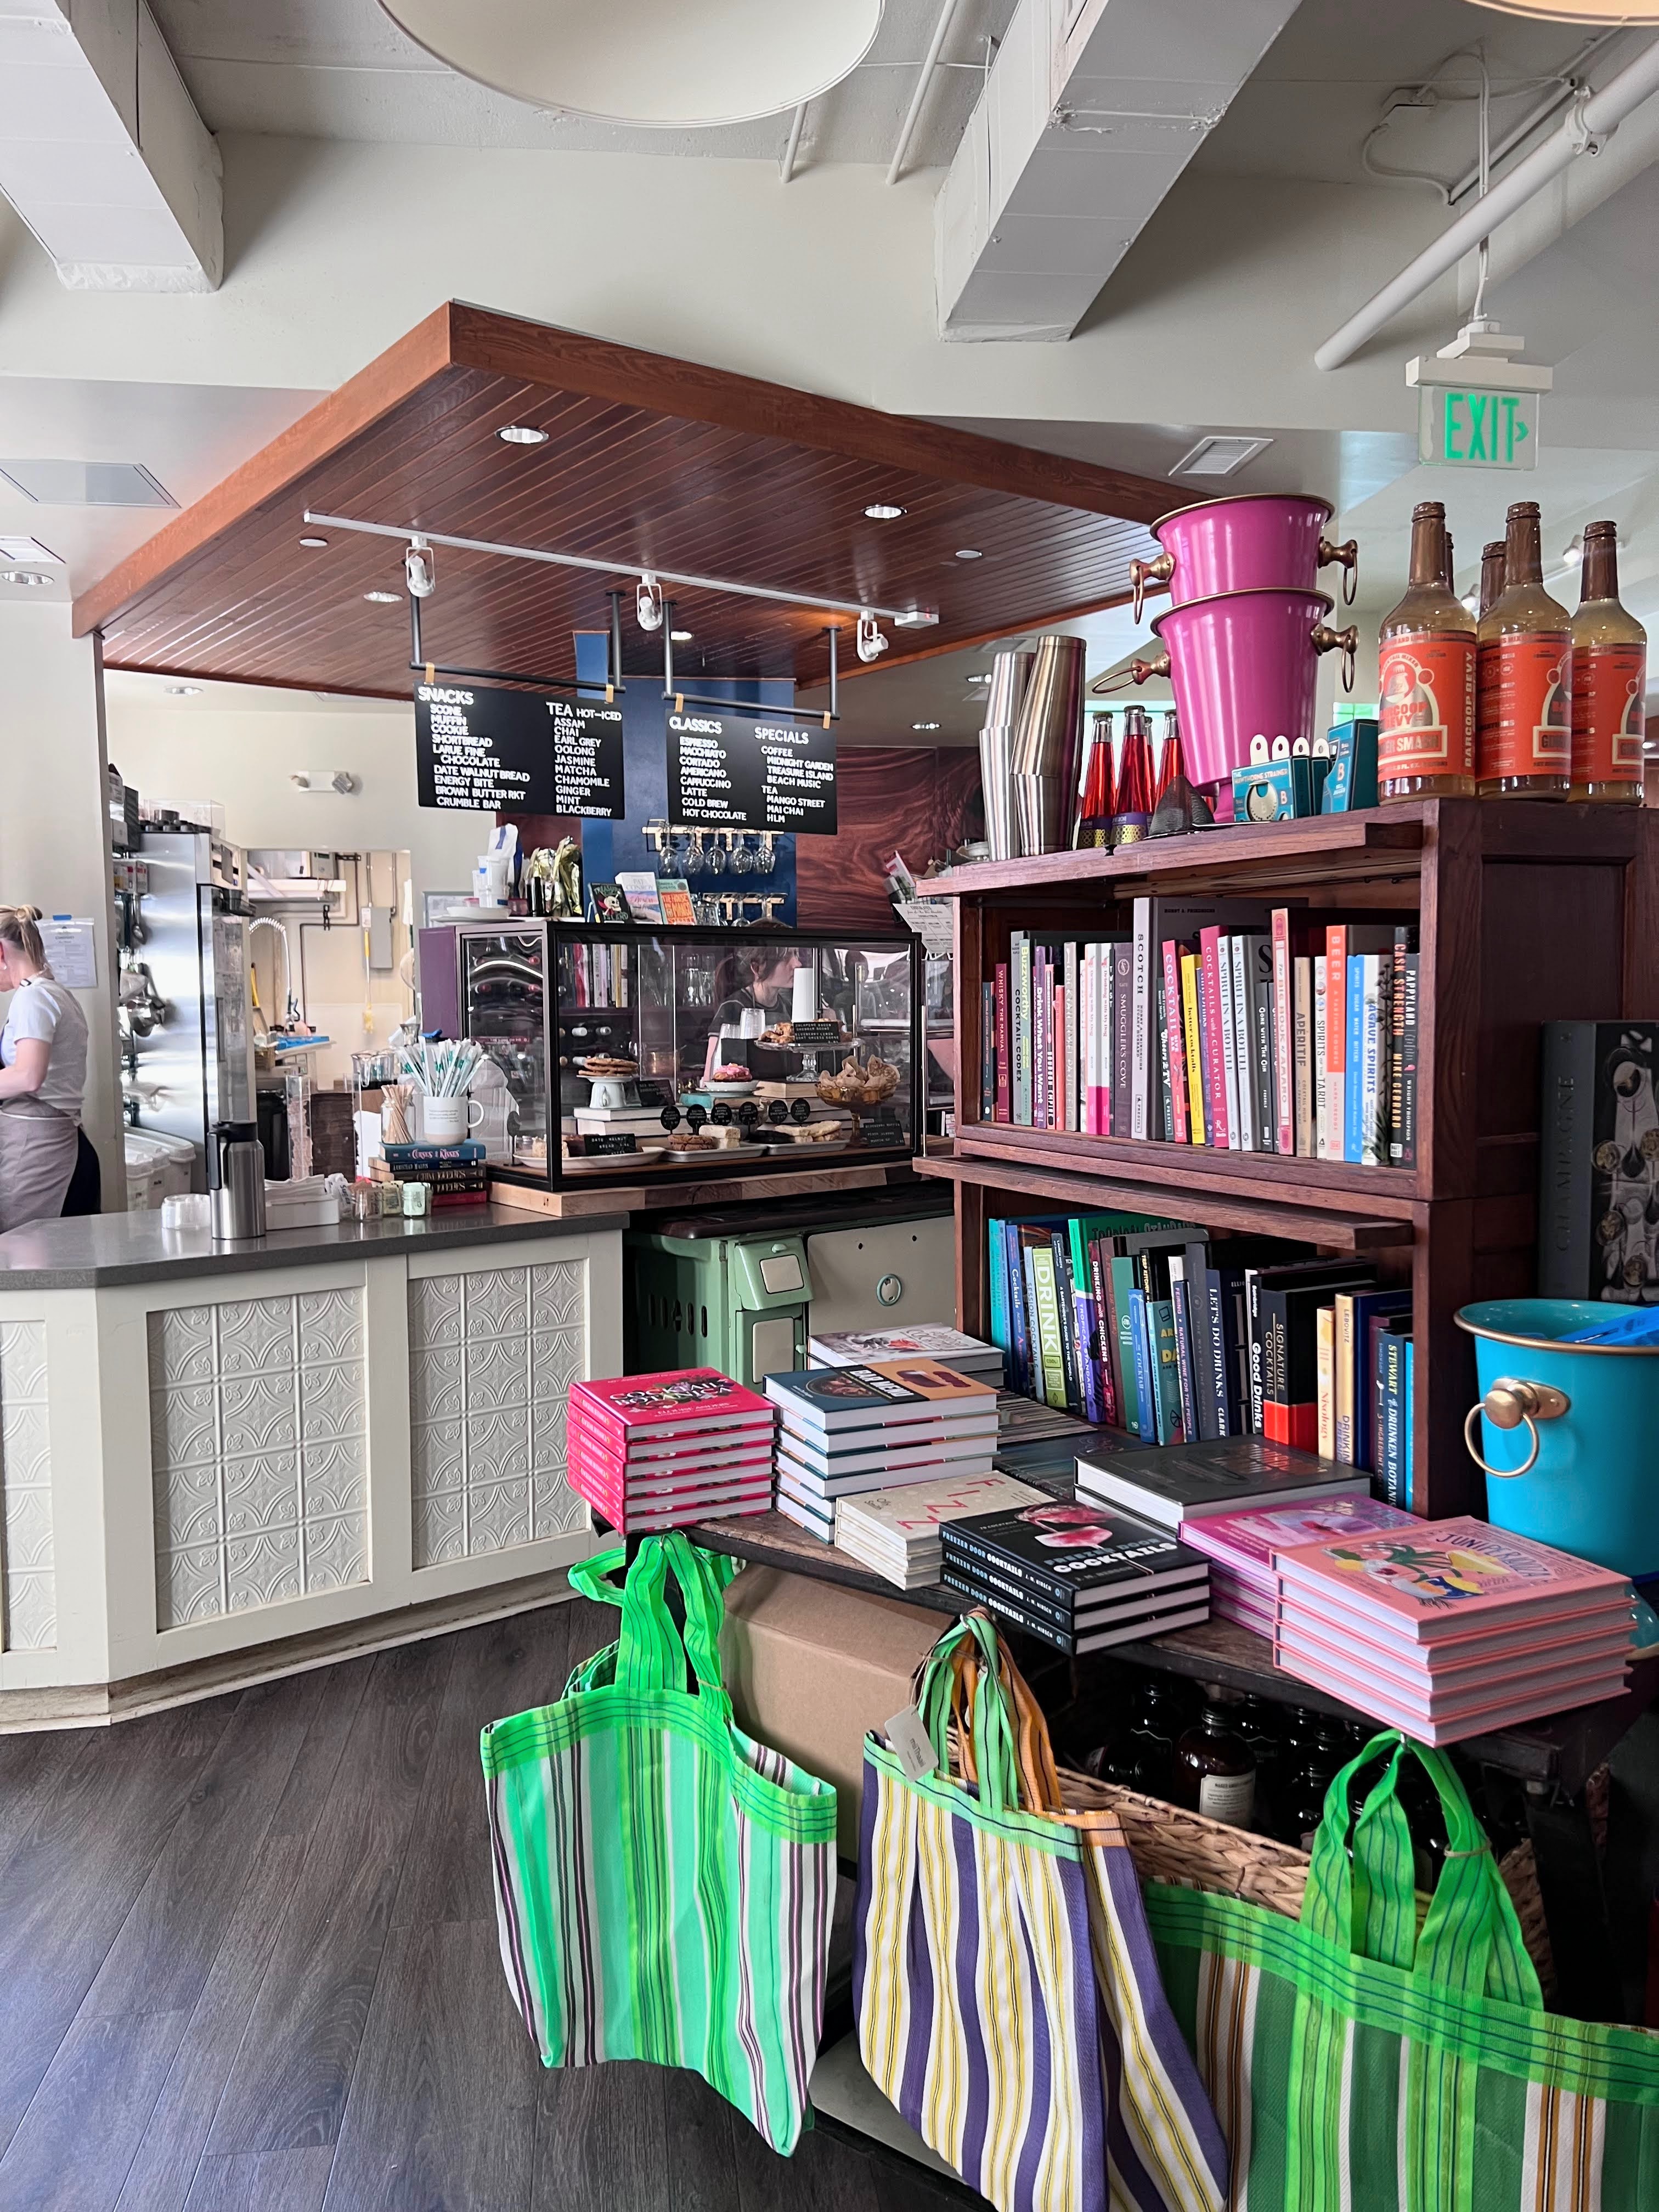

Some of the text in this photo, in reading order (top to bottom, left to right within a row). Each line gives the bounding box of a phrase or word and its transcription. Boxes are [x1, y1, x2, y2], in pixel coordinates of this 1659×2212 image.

[1445, 392, 1520, 462] EXIT
[418, 686, 473, 705] SNACKS
[430, 704, 462, 716] SCONE
[546, 702, 572, 716] TEA
[1465, 651, 1475, 767] BARCOOP BEVY
[431, 714, 466, 726] MUFFIN
[554, 718, 585, 729] ASSAM
[669, 716, 723, 735] CLASSICS
[431, 724, 469, 736] COOKIE
[554, 727, 579, 736] CHAI
[755, 727, 809, 744] SPECIALS
[432, 734, 493, 747] SHORTBREAD
[555, 735, 601, 748] EARL GREY
[680, 736, 718, 748] ESPRESSO
[433, 744, 486, 757] LARUE FINE
[555, 744, 595, 756] OOLONG
[680, 746, 726, 759] MACCHIATO
[761, 746, 793, 757] COFFEE
[441, 754, 500, 768] CHOCOLATE
[555, 755, 595, 766] JASMINE
[679, 757, 720, 768] CORTADO
[767, 757, 833, 771] MIDNIGHT GARDEN
[435, 765, 530, 782] DATE WALNUT BREAD
[555, 765, 596, 776] MATCHA
[680, 767, 726, 778] AMERICANO
[767, 766, 833, 781] TREASURE ISLAND
[435, 776, 494, 788] ENERGY BITE
[555, 775, 610, 787] CHAMOMILE
[680, 777, 731, 789] CAPPUCCINO
[767, 775, 821, 789] BEACH MUSIC
[436, 785, 507, 799] BROWN BUTTER
[556, 785, 591, 796] GINGER
[681, 788, 708, 797] LATTE
[761, 785, 778, 795] TEA
[437, 797, 501, 809] CRUMBLE BAR
[556, 795, 580, 805] MINT
[682, 798, 728, 809] COLD BREW
[767, 795, 825, 808] MANGO STREET
[556, 804, 612, 817] BLACKBERRY
[682, 808, 747, 821] HOT CHOCOLATE
[767, 805, 804, 816] MAI CHAI
[767, 815, 785, 823] HLM
[1331, 936, 1340, 980] BEER
[1220, 962, 1228, 998] SPIRIT
[1234, 961, 1243, 999] SPIRIT
[1165, 954, 1177, 1032] COCKTAIL
[1393, 944, 1406, 1036] CASK STRENGTH
[1406, 970, 1415, 1025] PAPPYLAND
[1205, 947, 1216, 1014] COCKTAILS
[1211, 1040, 1221, 1099] CURATOR
[1367, 1005, 1377, 1093] AGAVE SPIRITS
[1317, 1020, 1326, 1109] SPIRITS TAROT
[1393, 1054, 1402, 1078] MIKE
[1162, 1070, 1170, 1088] TV
[412, 1149, 459, 1159] CURSES KISSES
[1557, 1076, 1575, 1251] CHAMPAGNE
[1012, 1269, 1020, 1308] Cocktails
[1036, 1266, 1059, 1351] DRINK
[1093, 1261, 1102, 1301] DRINKING
[1098, 1320, 1108, 1362] CHICKENS
[1209, 1289, 1226, 1437] LET'S DO DRINKS CLARK
[1252, 1342, 1261, 1381] Good
[1276, 1324, 1284, 1391] SIGNATURE
[1084, 1348, 1092, 1395] STANDARD
[1388, 1345, 1397, 1395] STEWART
[850, 1370, 914, 1397] BAR MENU
[615, 1387, 732, 1405] BOTANICA
[1254, 1385, 1263, 1427] Drinks
[1388, 1408, 1397, 1458] DRUNKEN
[896, 1479, 1006, 1530] FIZZ
[1044, 1538, 1160, 1565] FREEZER DOOR
[1053, 1543, 1177, 1573] COCKTAILS
[943, 1531, 1051, 1591] FREEZER DOOR COCKTAILS HIRSCH
[946, 1552, 1052, 1614] FREEZER DOOR COCKTAILS HIRSCH
[944, 1574, 1053, 1638] FREEZER DOOR COCKTAILS HIRSCH
